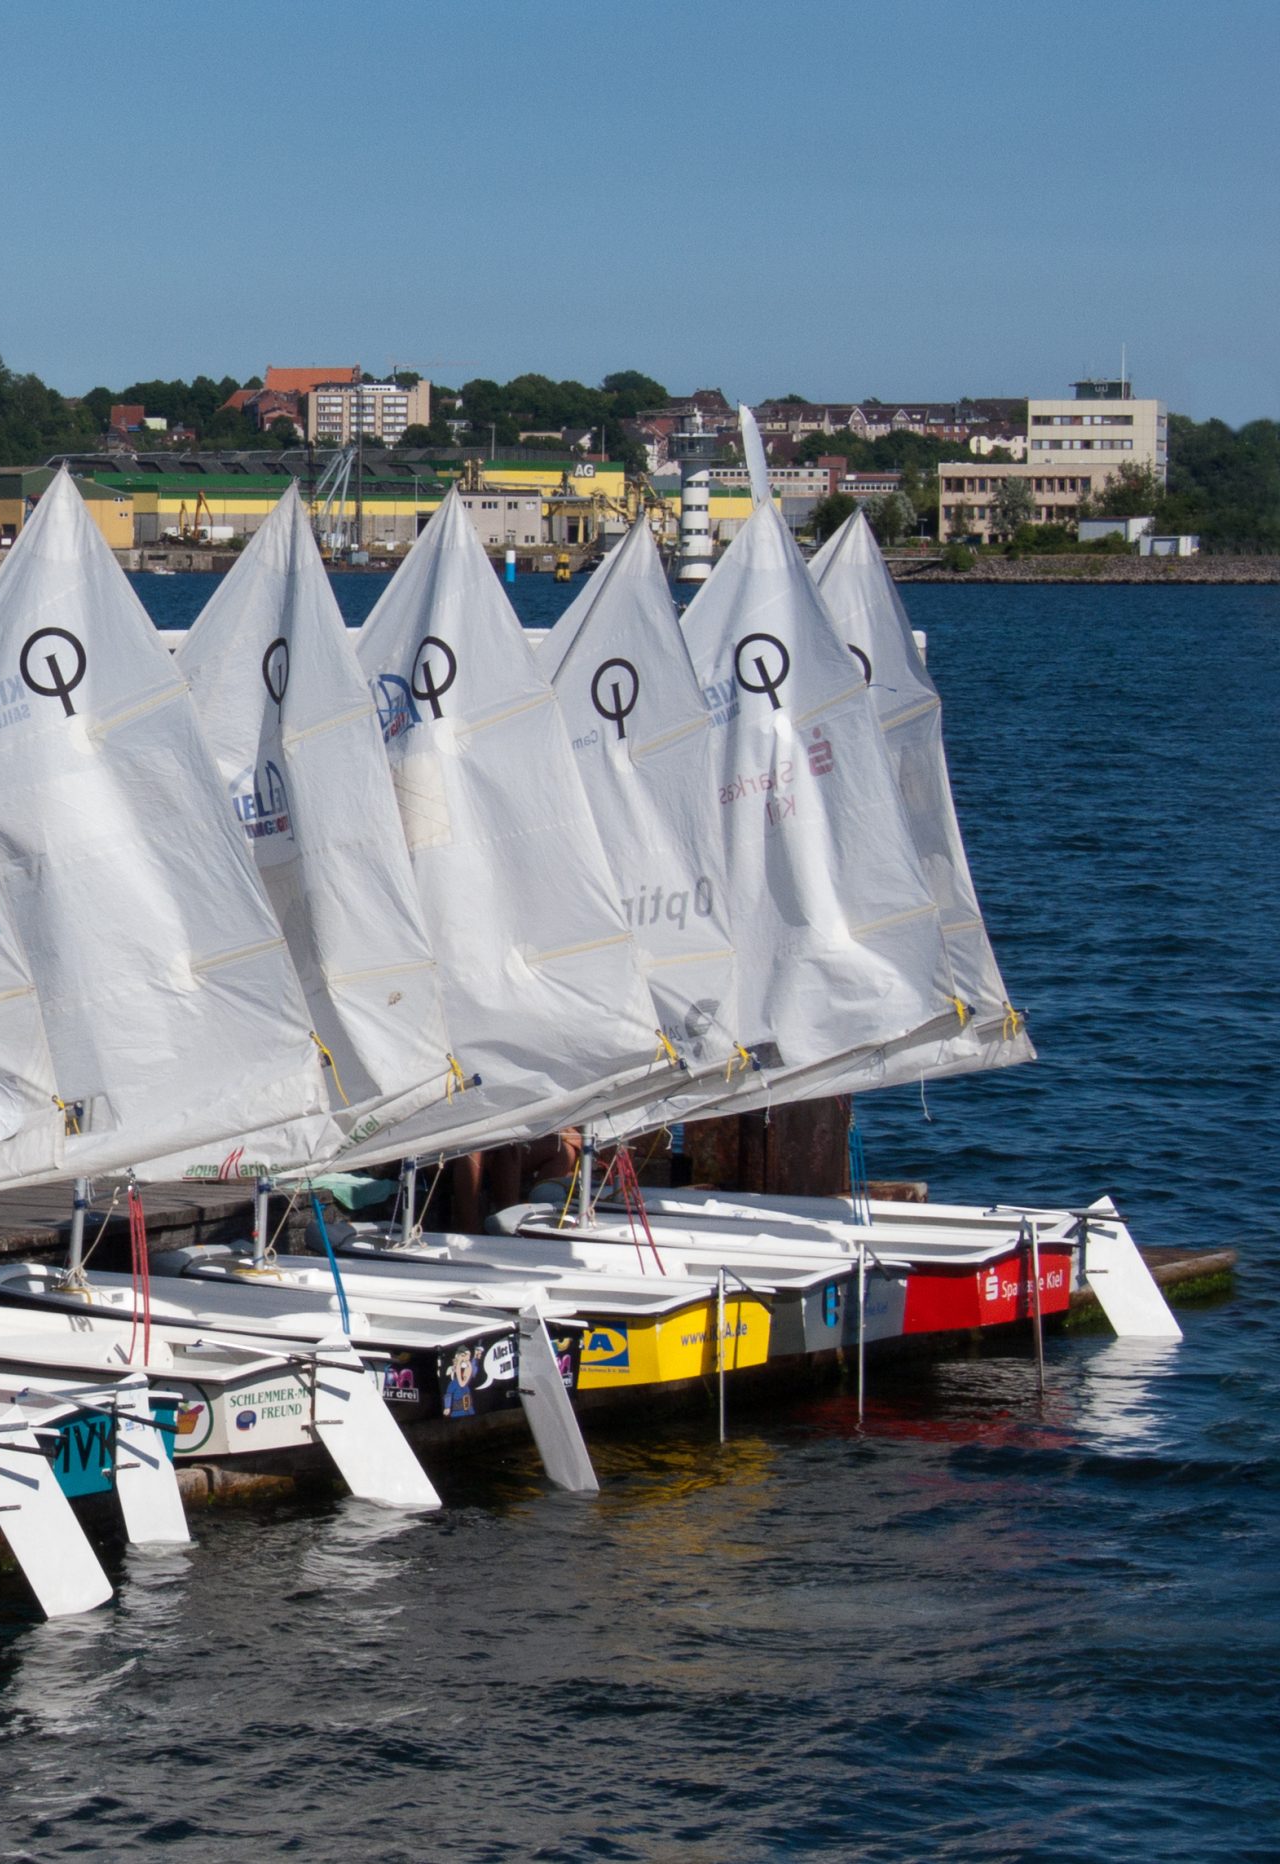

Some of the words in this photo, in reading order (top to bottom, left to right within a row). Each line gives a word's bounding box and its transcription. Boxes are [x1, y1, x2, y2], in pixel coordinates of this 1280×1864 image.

[574, 463, 595, 477] AG
[1047, 1269, 1063, 1289] Kiel
[396, 1390, 417, 1400] drei
[261, 1403, 303, 1420] FREUND
